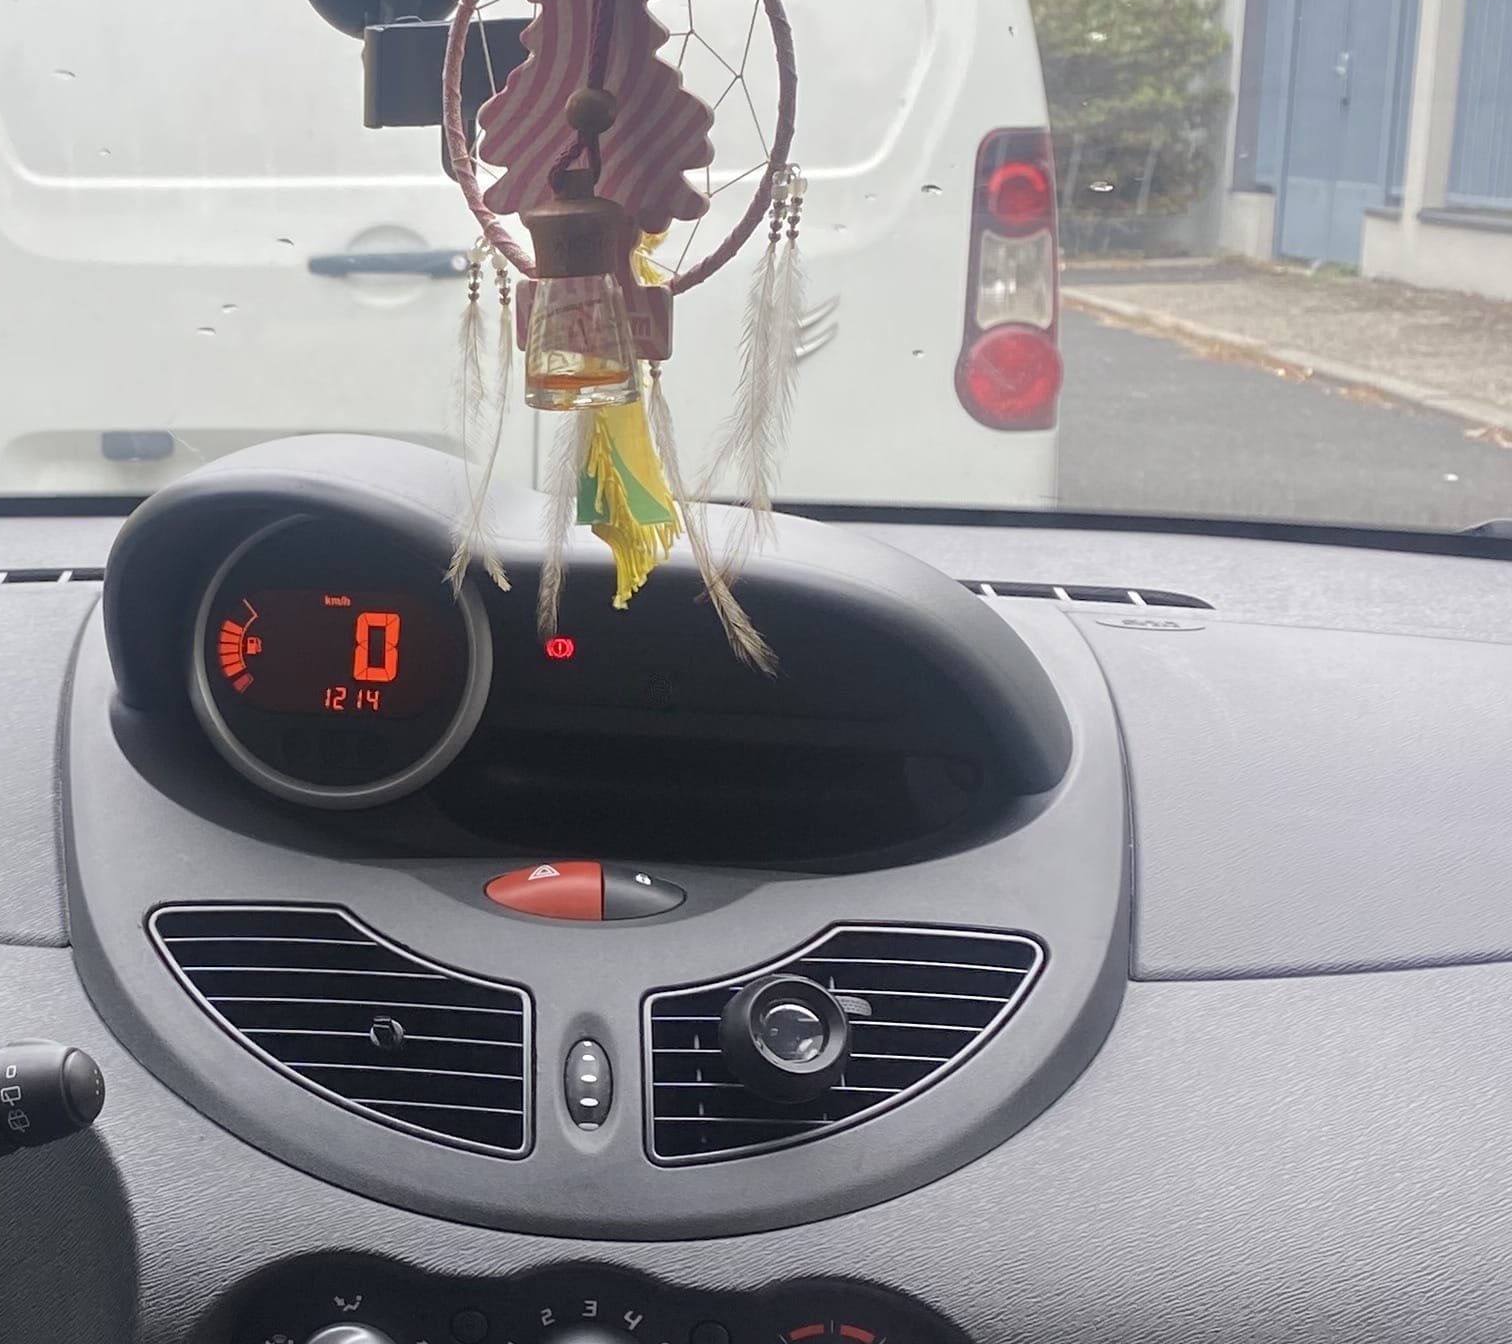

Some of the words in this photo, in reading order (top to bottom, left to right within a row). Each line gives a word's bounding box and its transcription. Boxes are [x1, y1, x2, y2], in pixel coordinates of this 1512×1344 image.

[353, 611, 400, 682] 0
[540, 1308, 556, 1326] 2
[581, 1300, 598, 1317] 3
[623, 1310, 643, 1331] 4
